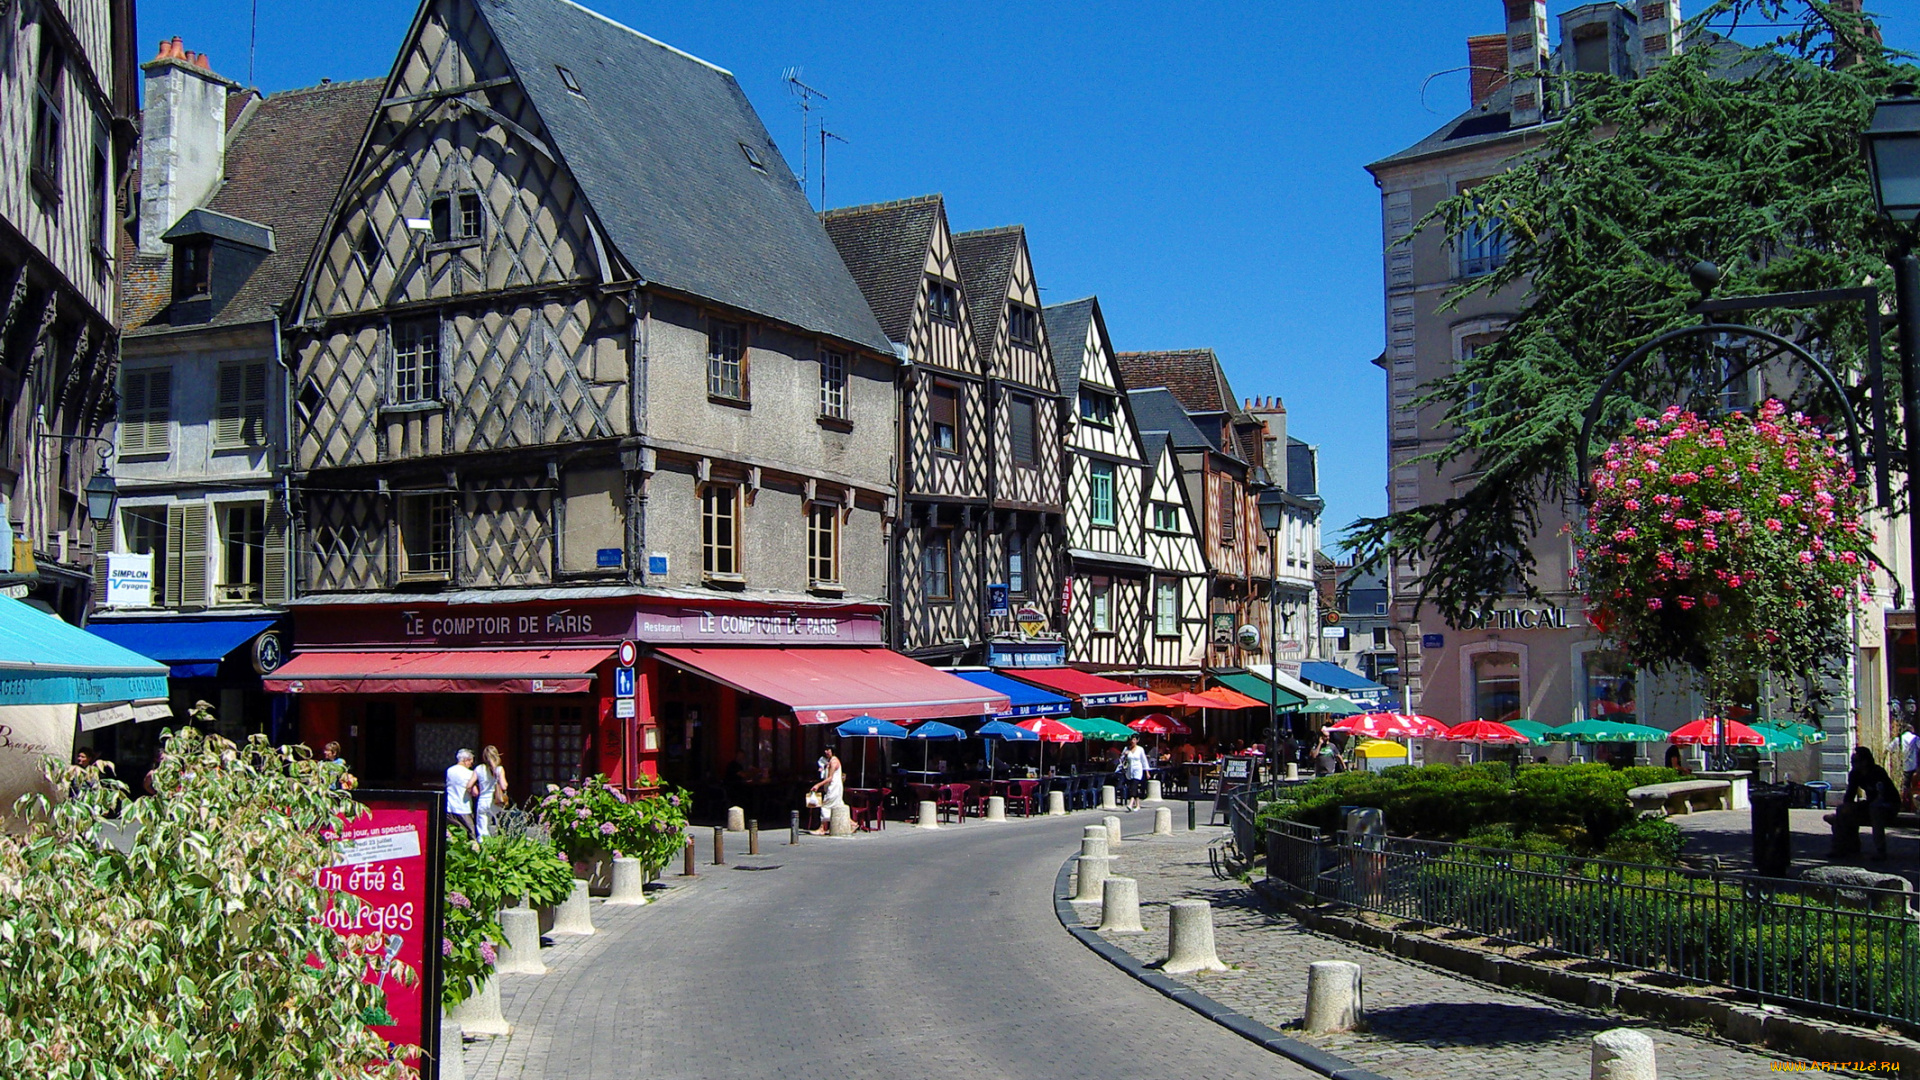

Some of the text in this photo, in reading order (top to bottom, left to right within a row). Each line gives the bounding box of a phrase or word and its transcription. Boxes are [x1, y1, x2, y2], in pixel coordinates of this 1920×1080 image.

[112, 569, 149, 578] SIMPLON
[111, 579, 149, 590] Voyages
[1062, 576, 1072, 614] TABAC
[406, 615, 593, 635] LE COMPTOIR DE PARIS
[699, 615, 837, 635] LE COMPTOIR DE PARIS
[1462, 608, 1568, 630] OPTICAL
[353, 828, 369, 838] jour,
[381, 823, 416, 834] spectacle
[349, 863, 385, 891] été
[392, 865, 405, 892] à
[321, 901, 414, 952] ourges
